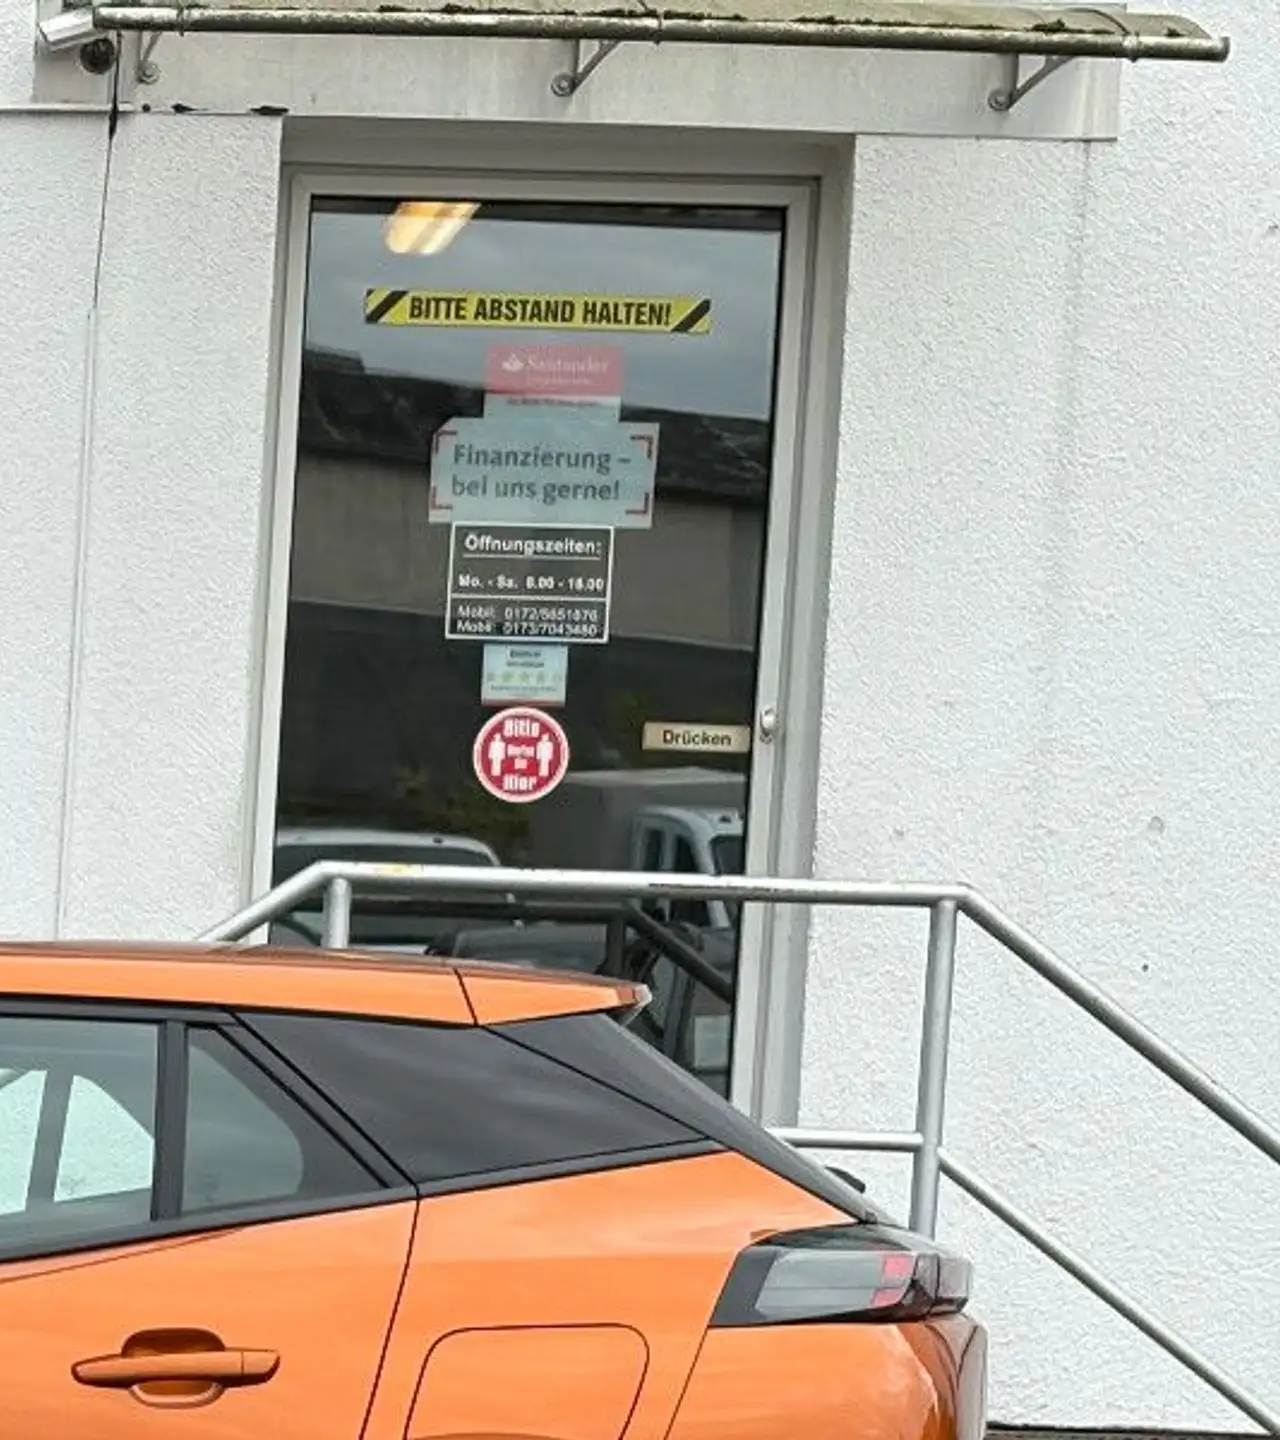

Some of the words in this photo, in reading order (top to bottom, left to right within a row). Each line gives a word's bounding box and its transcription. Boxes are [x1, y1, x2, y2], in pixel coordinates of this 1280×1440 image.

[408, 296, 467, 321] BITTE
[474, 298, 574, 324] ABSTAND
[582, 299, 672, 326] HALTEN!
[453, 443, 612, 476] Finanzierung
[451, 473, 488, 498] bei
[495, 479, 537, 501] uns
[542, 479, 620, 506] gerne!
[464, 532, 602, 557] Öffnungszeiten:
[503, 717, 540, 738] Bitte
[662, 728, 733, 746] Drücken
[503, 773, 538, 791] Hier
